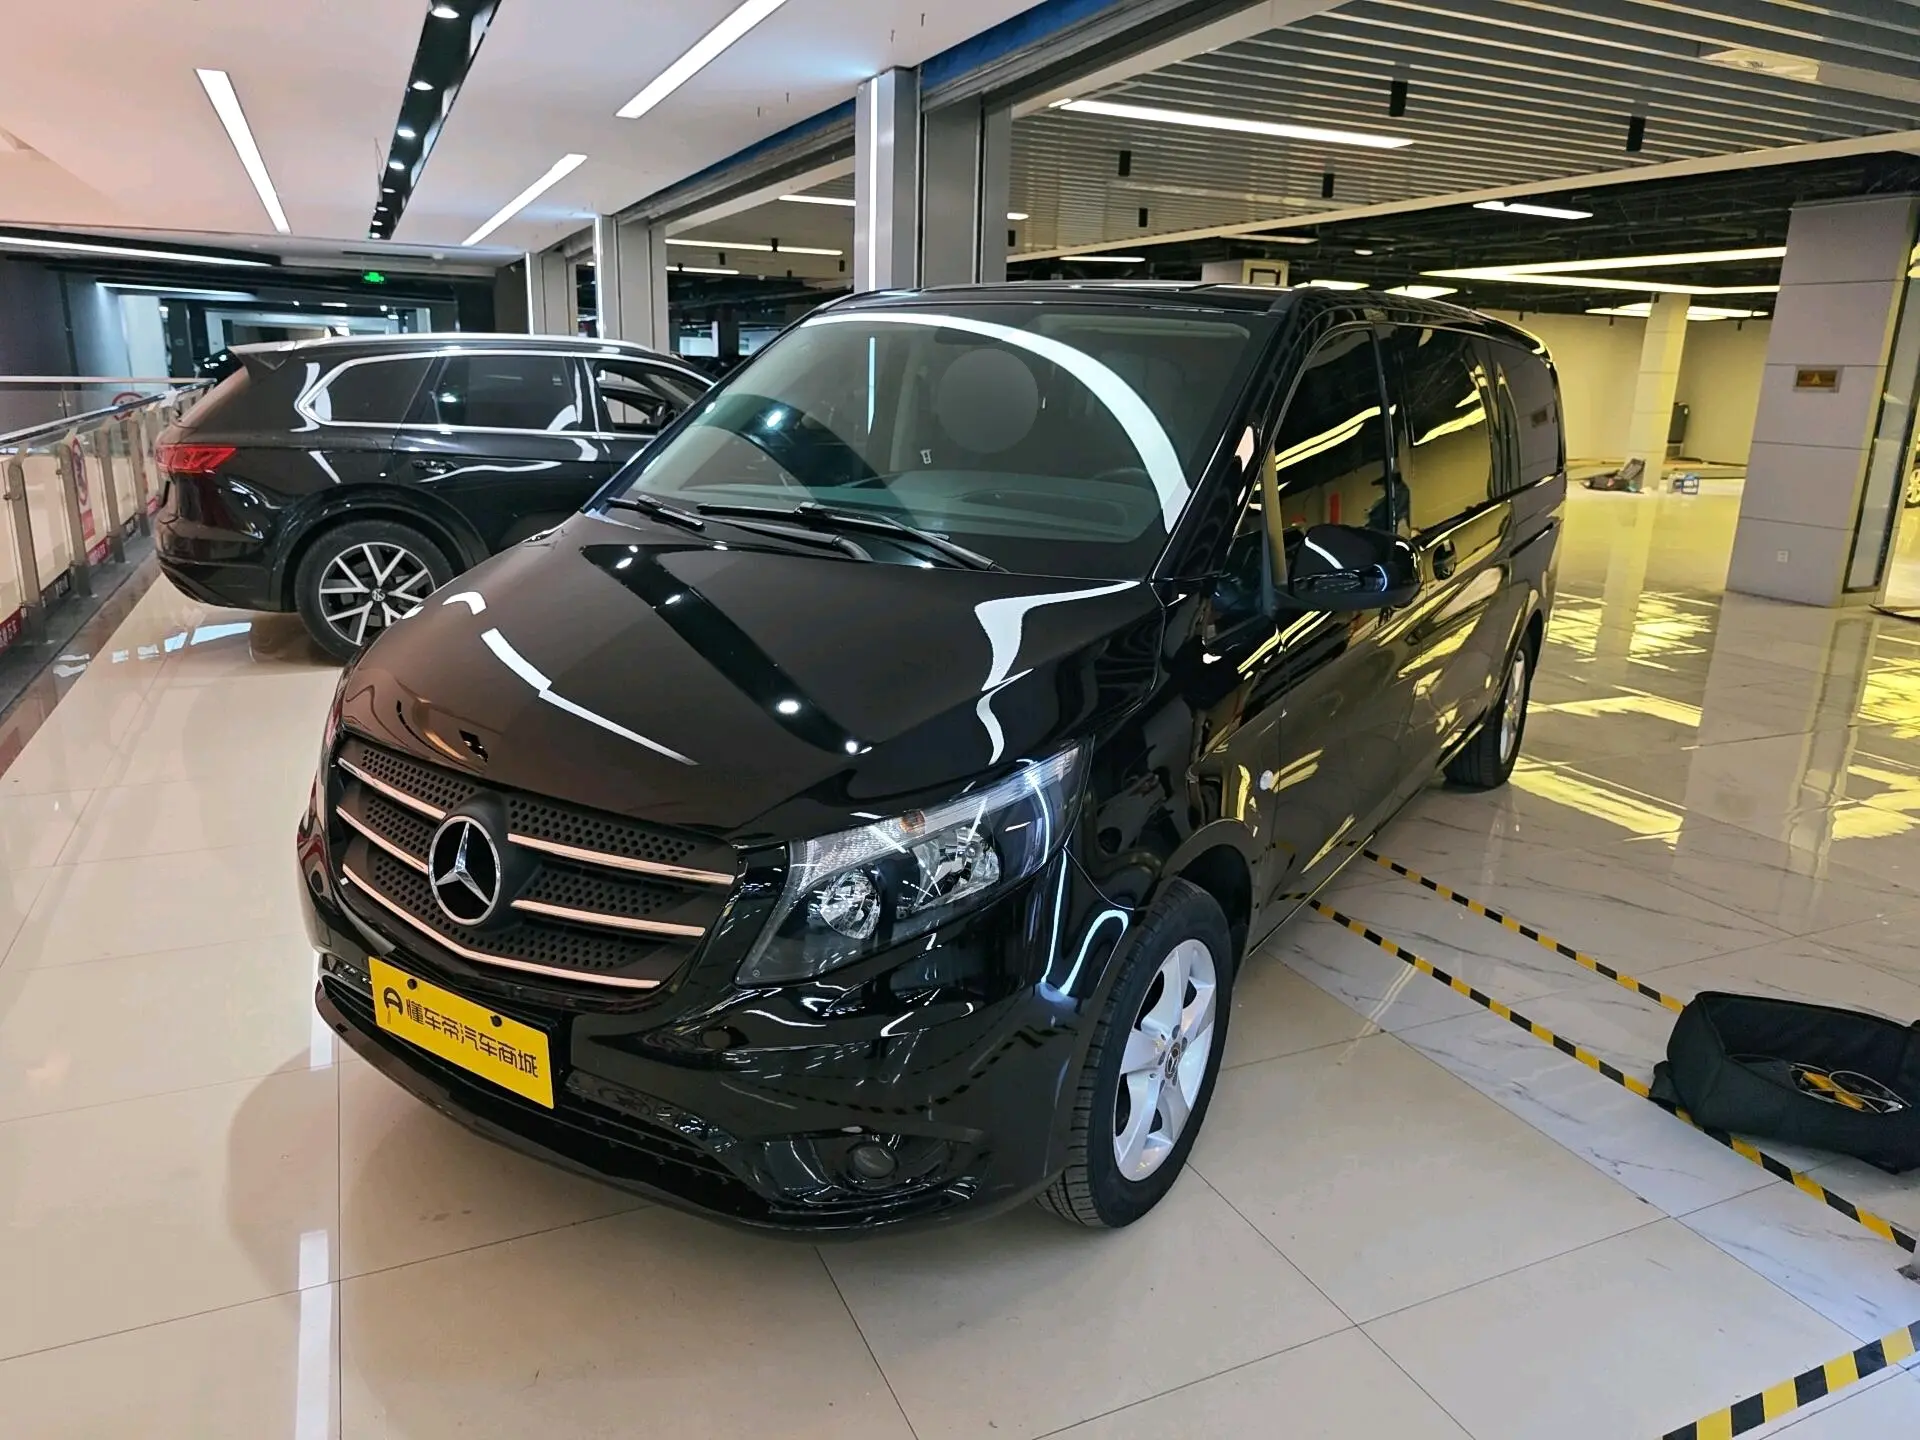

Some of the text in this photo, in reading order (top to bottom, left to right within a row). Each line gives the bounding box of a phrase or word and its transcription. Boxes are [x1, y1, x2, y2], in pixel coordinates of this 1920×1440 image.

[405, 998, 539, 1079] 懂车帝汽车商城
